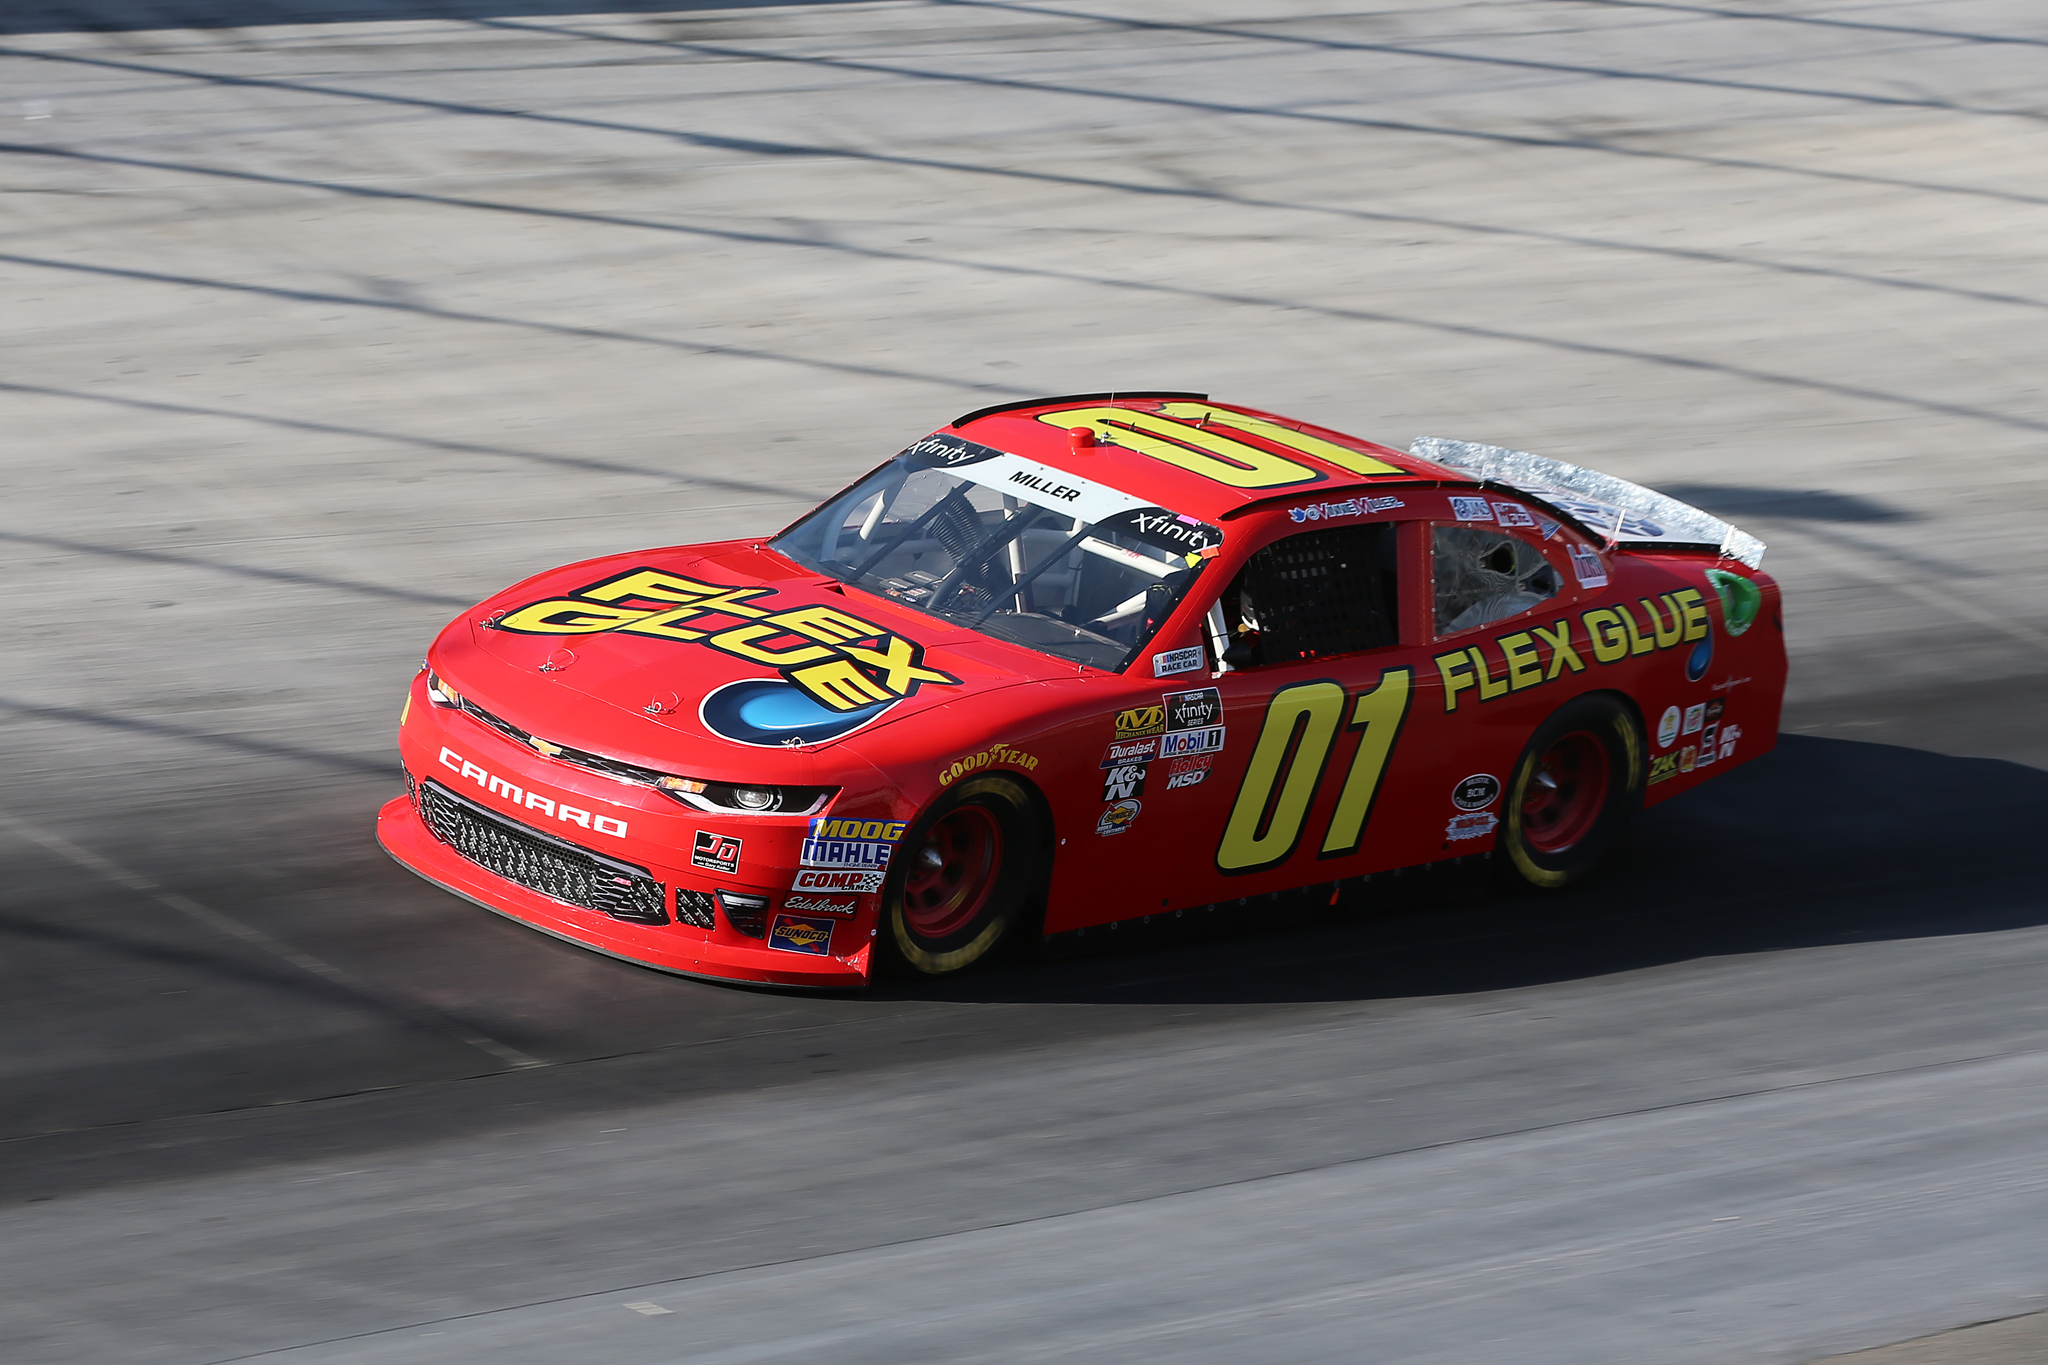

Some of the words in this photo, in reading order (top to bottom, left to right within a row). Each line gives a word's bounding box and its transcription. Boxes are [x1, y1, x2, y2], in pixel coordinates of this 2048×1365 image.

[908, 439, 975, 465] xfinity
[1036, 402, 1407, 488] 01
[1008, 470, 1082, 502] MILLER
[1130, 512, 1220, 552] xfinity
[590, 569, 953, 697] FLEX
[500, 599, 894, 711] GLUE
[1168, 650, 1198, 662] NASCAR
[1434, 619, 1586, 712] FLEX
[1582, 587, 1709, 665] GLUE
[1161, 663, 1182, 673] RACE
[1183, 660, 1198, 670] CAR
[1175, 702, 1213, 724] xfinity
[1187, 717, 1204, 727] SERIES
[1145, 724, 1165, 735] WEAR
[1109, 740, 1156, 759] Duralast
[1164, 732, 1205, 753] Mobil
[1117, 756, 1143, 765] BRAKES
[1169, 754, 1214, 777] Holley
[1216, 669, 1411, 871] 01
[1649, 751, 1680, 777] ZAK
[1166, 771, 1206, 790] MSD
[438, 746, 628, 839] CAMARO
[812, 819, 906, 841] MOOG
[694, 855, 735, 867] MOTORSPORTS
[803, 840, 890, 865] MAHLE
[799, 872, 864, 888] COMP
[784, 896, 855, 915] Edelbrock
[775, 926, 828, 942] SUNOCO
